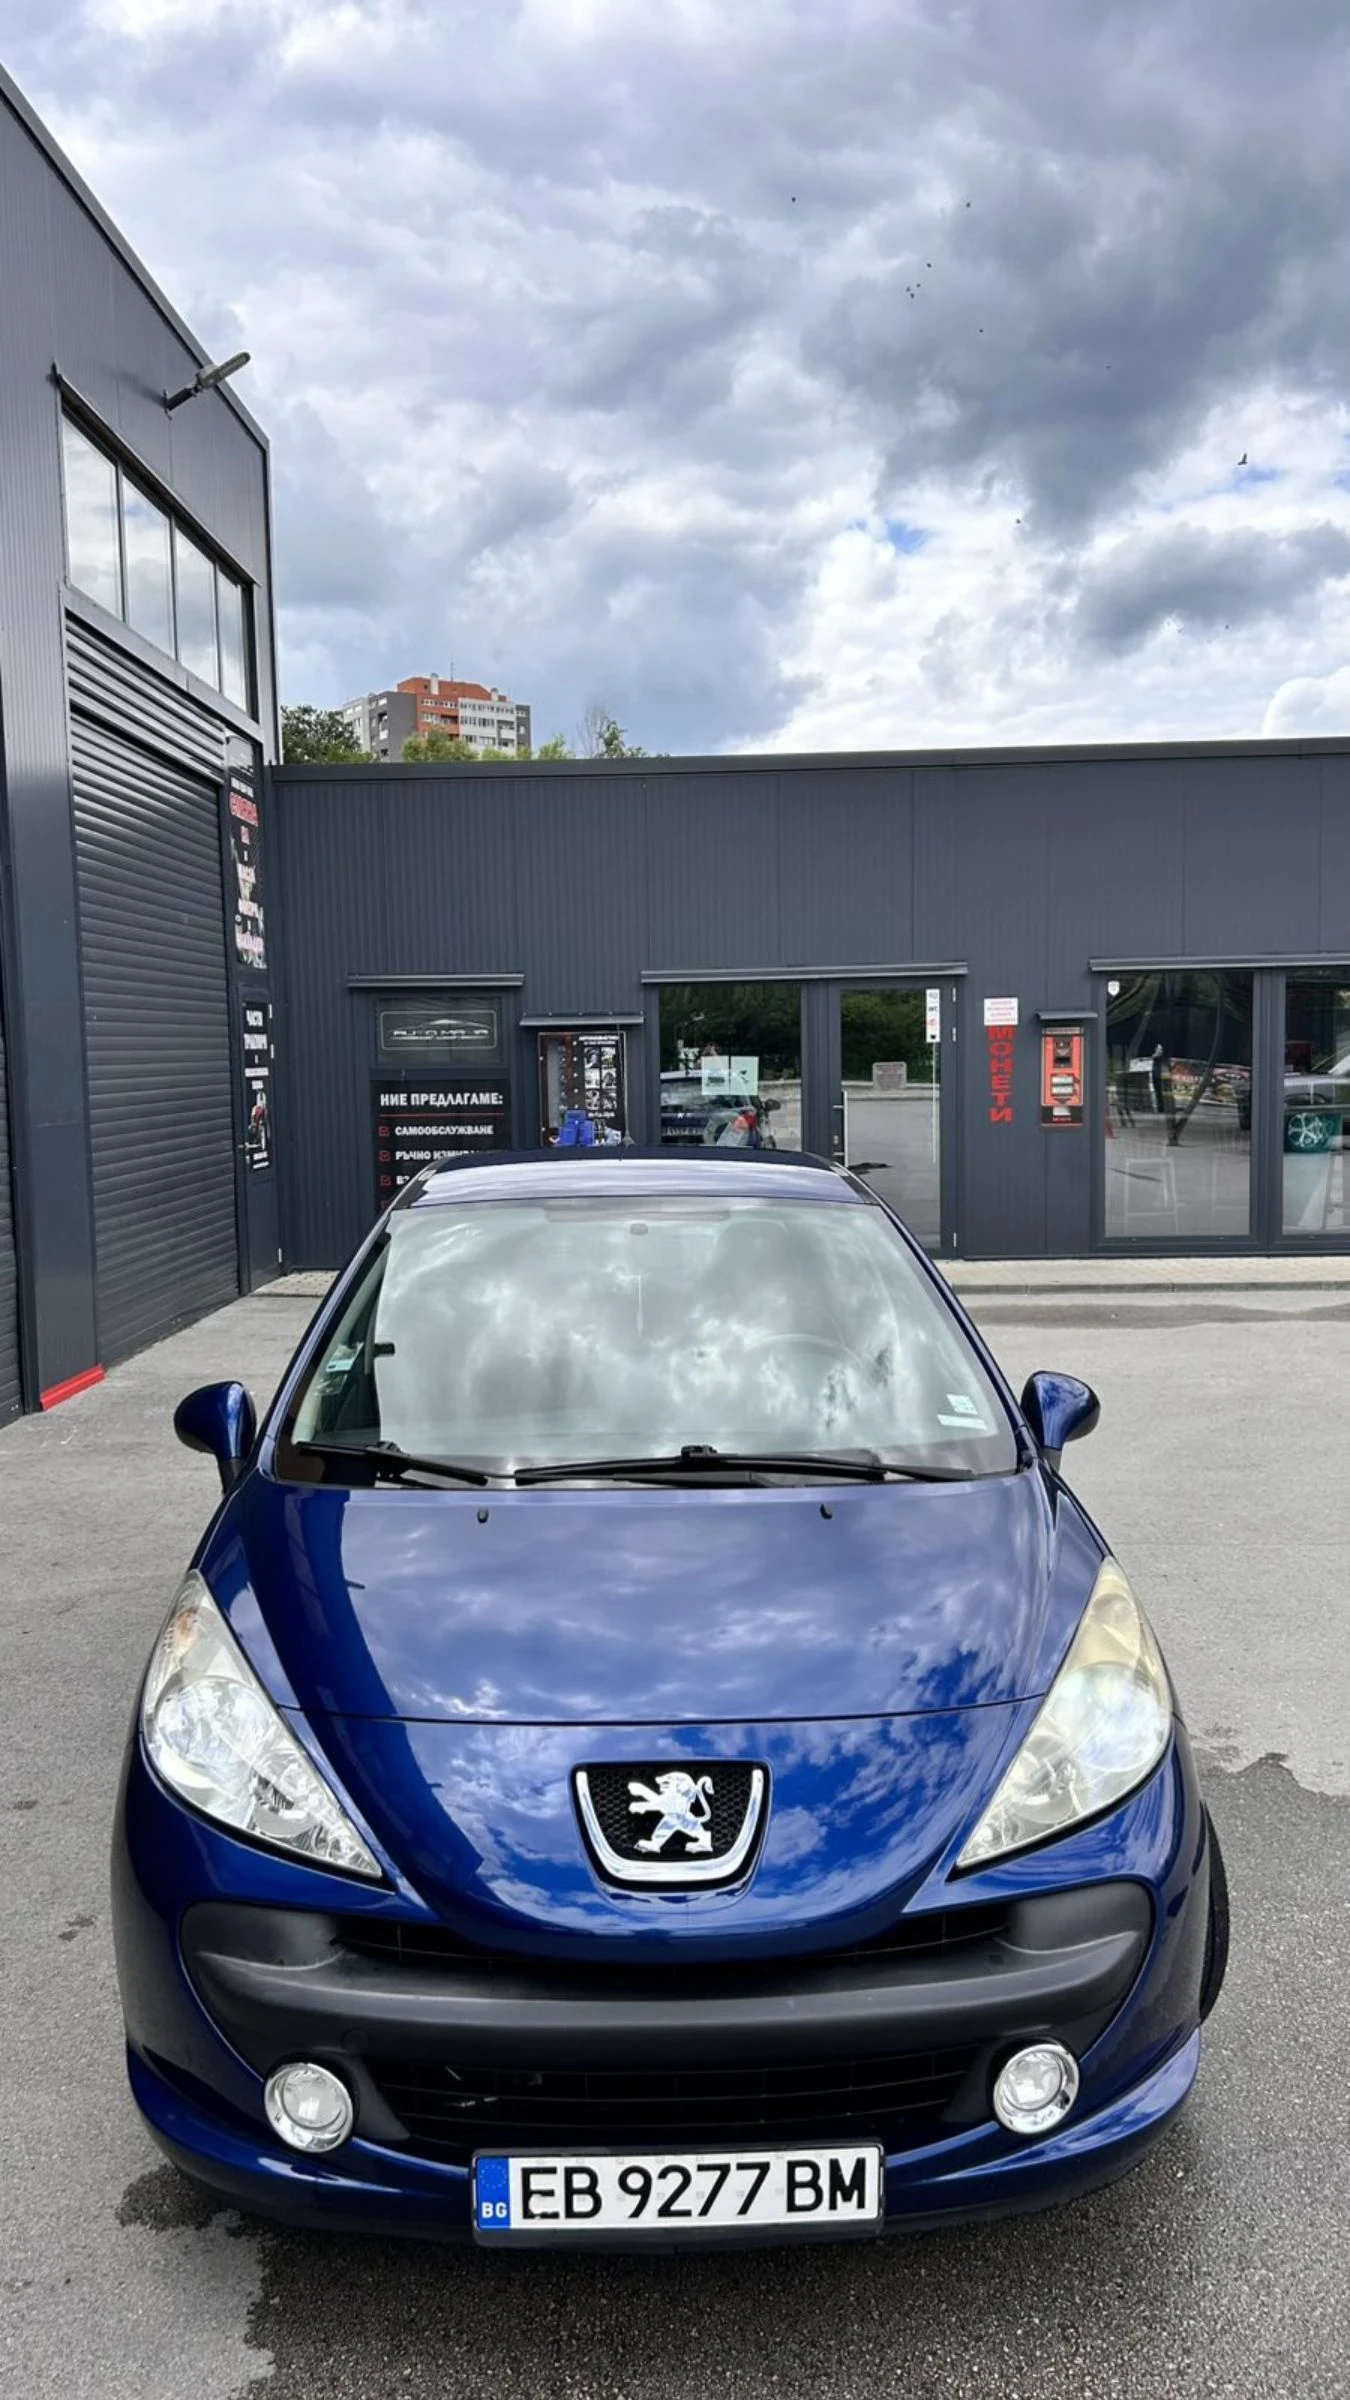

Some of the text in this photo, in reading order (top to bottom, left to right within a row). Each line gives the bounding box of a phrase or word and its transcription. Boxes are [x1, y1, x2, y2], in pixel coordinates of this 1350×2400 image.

[988, 1025, 1015, 1122] МОНЕТИ
[380, 1092, 504, 1107] НИЕ ПРЕДЛАГАМЕ:
[394, 1125, 494, 1136] САМООБСЛУЖВАНЕ
[395, 1150, 431, 1160] РЪЧНО
[521, 2156, 867, 2220] EB 9277 BM
[481, 2202, 508, 2219] BG
